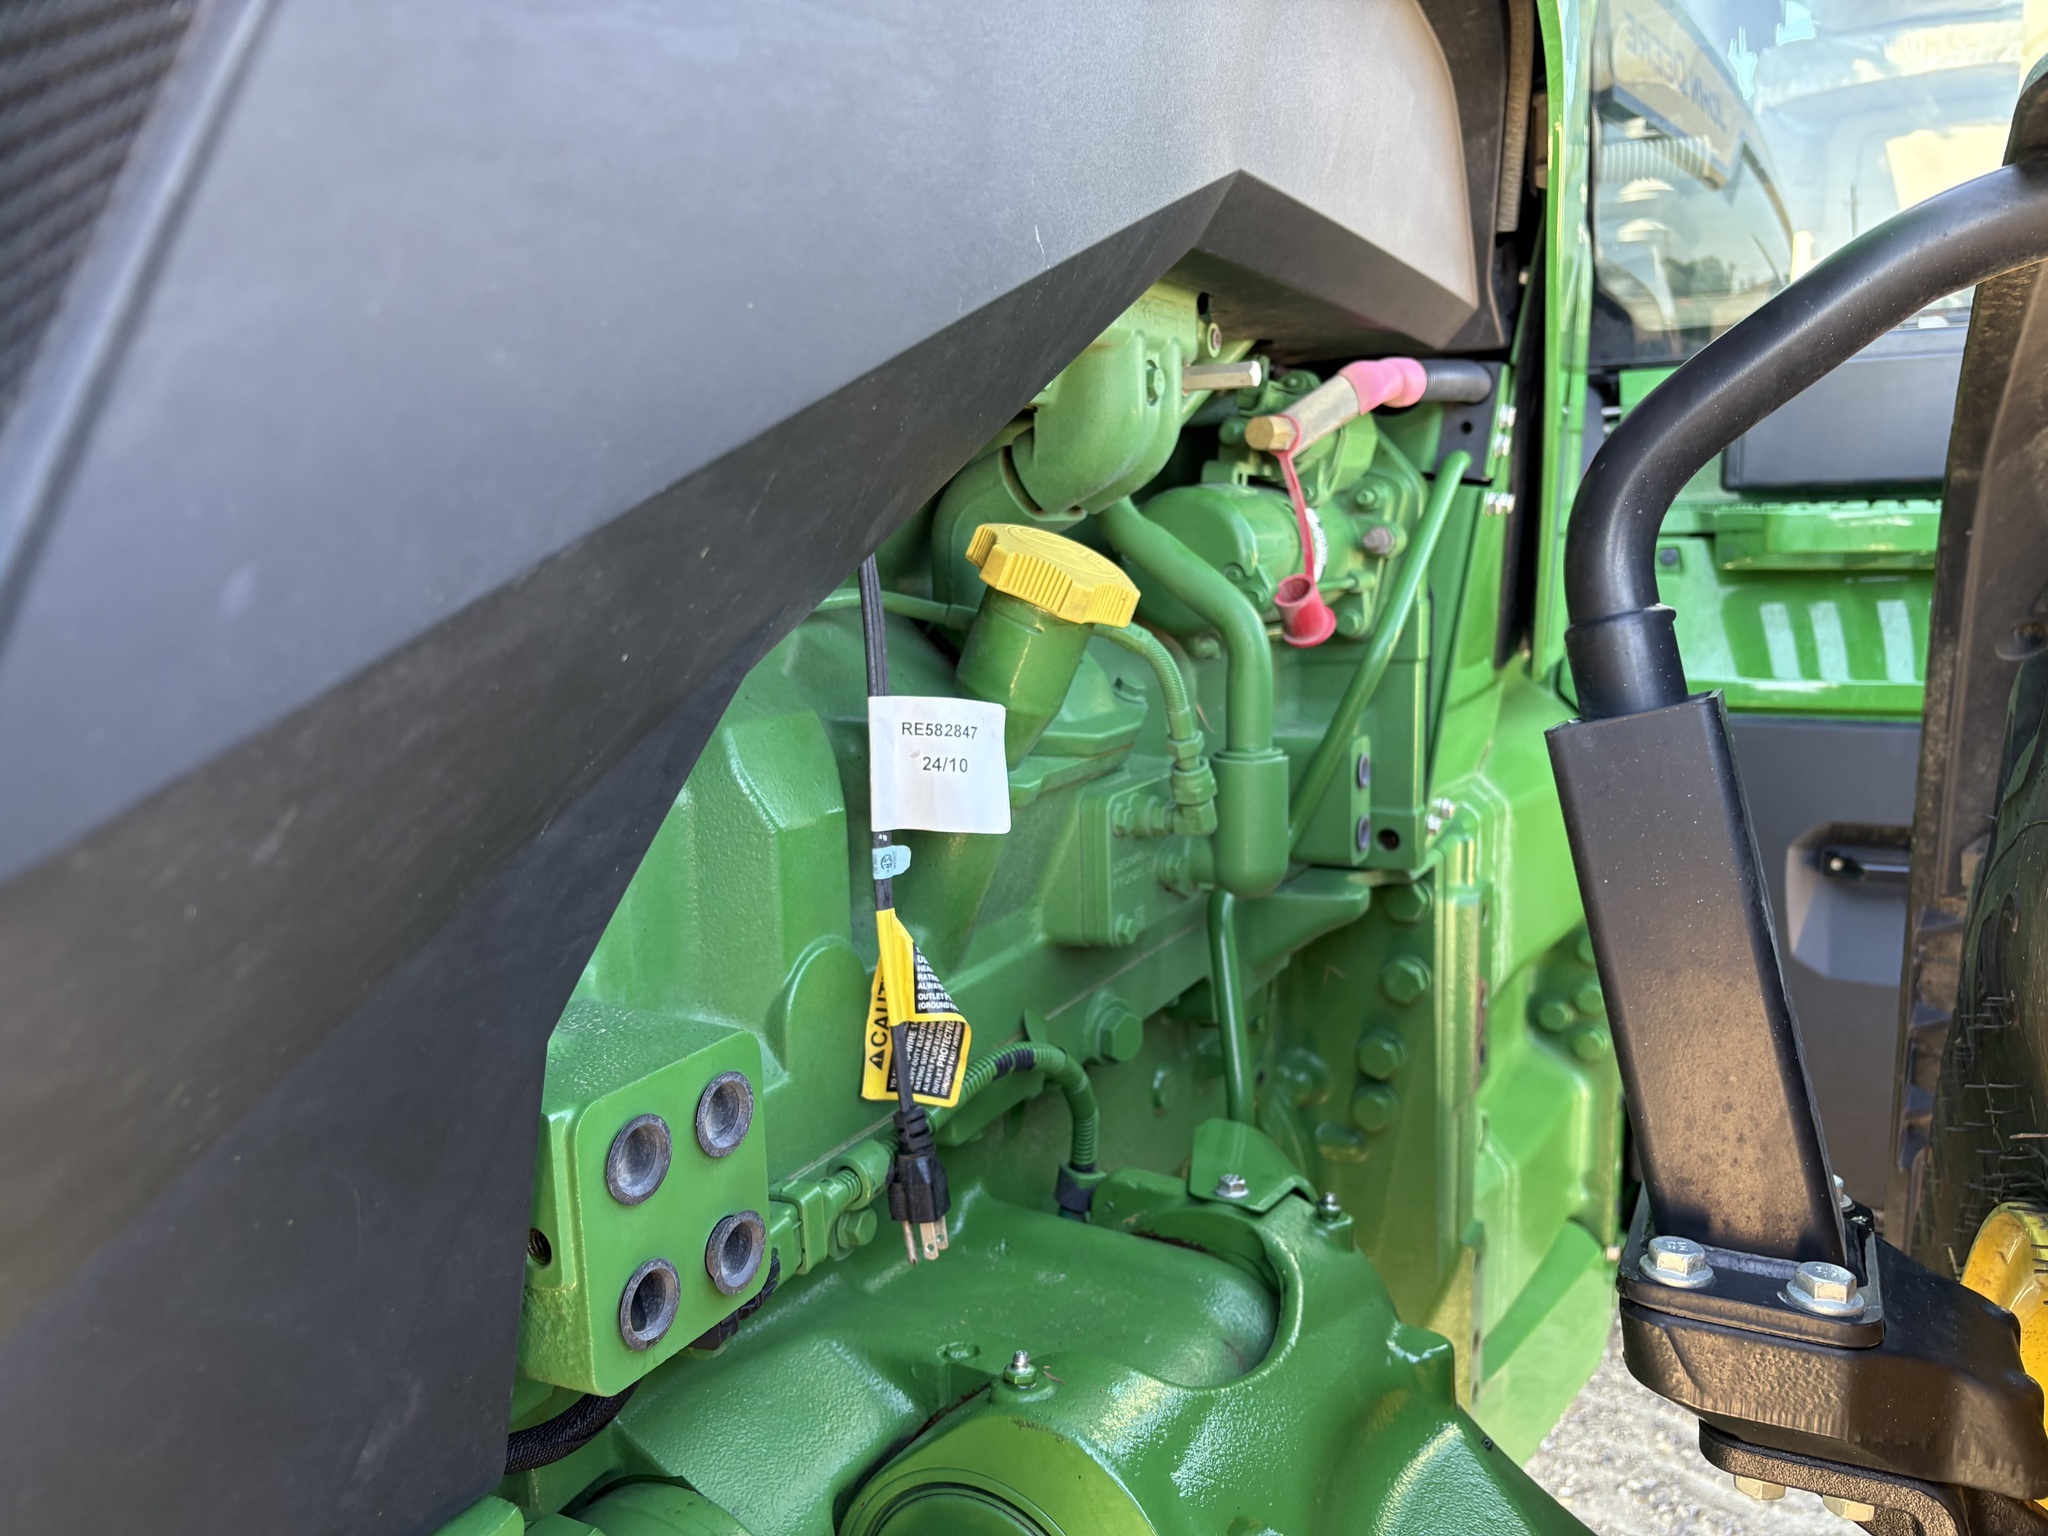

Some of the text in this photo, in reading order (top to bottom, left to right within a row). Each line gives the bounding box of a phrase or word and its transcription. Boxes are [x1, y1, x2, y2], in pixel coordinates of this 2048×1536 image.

[901, 721, 978, 740] RE582847
[922, 756, 968, 773] 24/10
[918, 992, 944, 1000] OUTLET
[914, 1066, 926, 1091] RATING
[920, 1033, 935, 1065] SUITABLE
[929, 1045, 940, 1064] PLUG
[923, 1064, 936, 1092] ALWAYS
[932, 1067, 945, 1094] OUTLET
